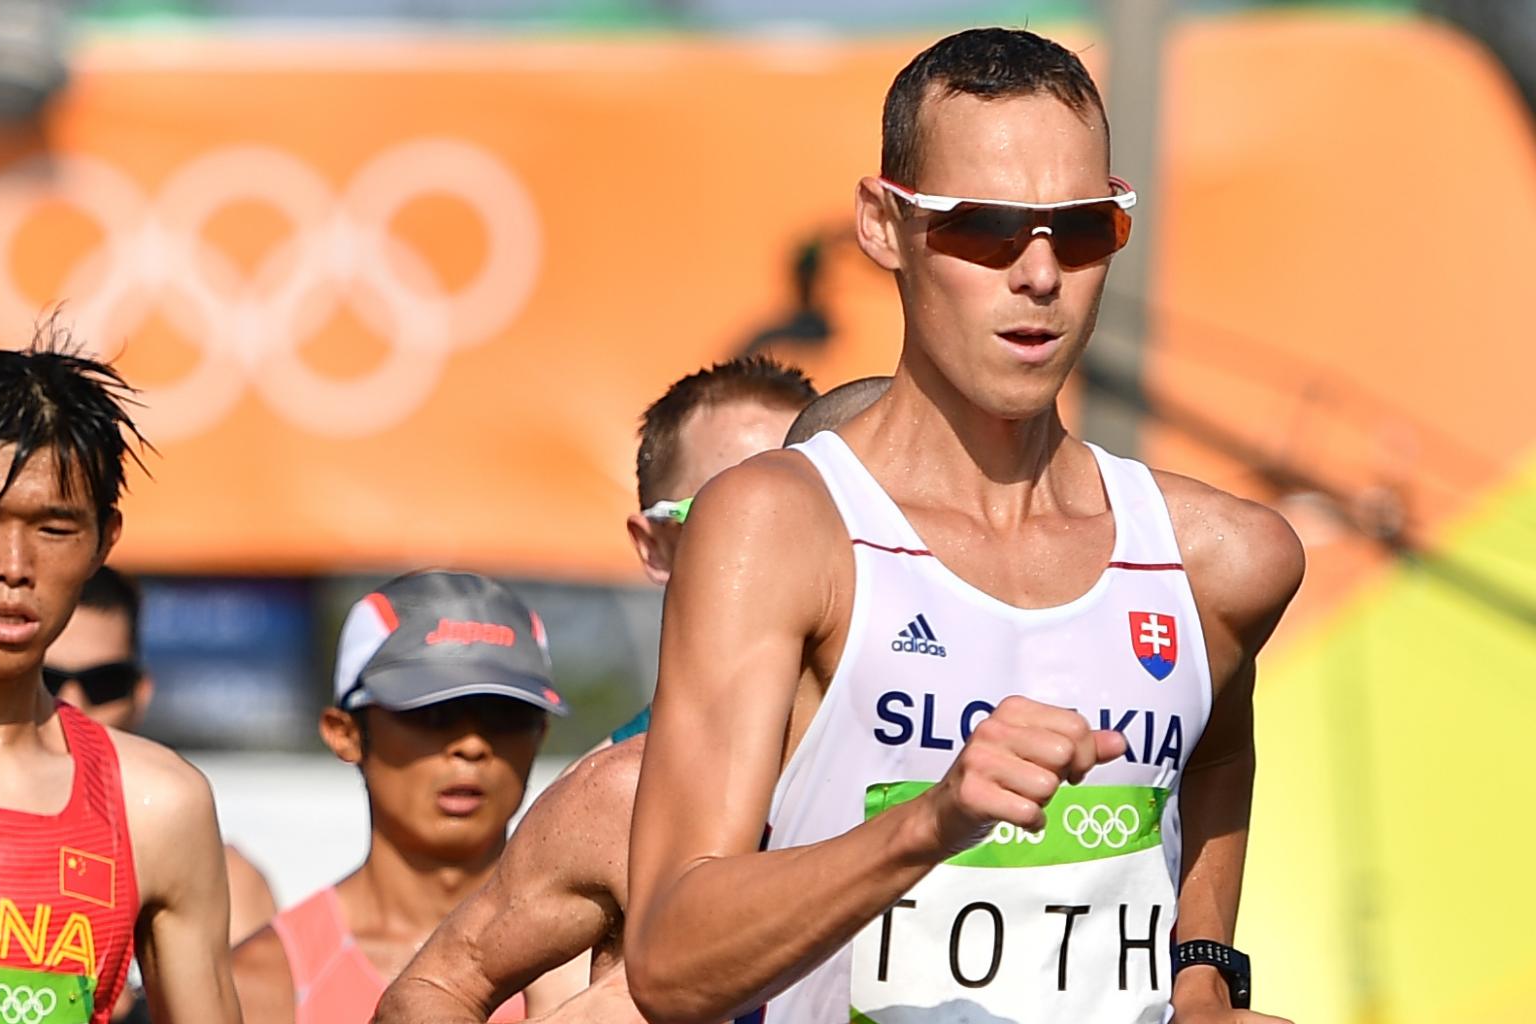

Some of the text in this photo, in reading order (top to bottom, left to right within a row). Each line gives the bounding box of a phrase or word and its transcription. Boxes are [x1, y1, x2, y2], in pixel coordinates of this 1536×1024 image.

[425, 617, 515, 647] Japan
[891, 633, 947, 658] adidas
[874, 898, 1162, 992] TOTH
